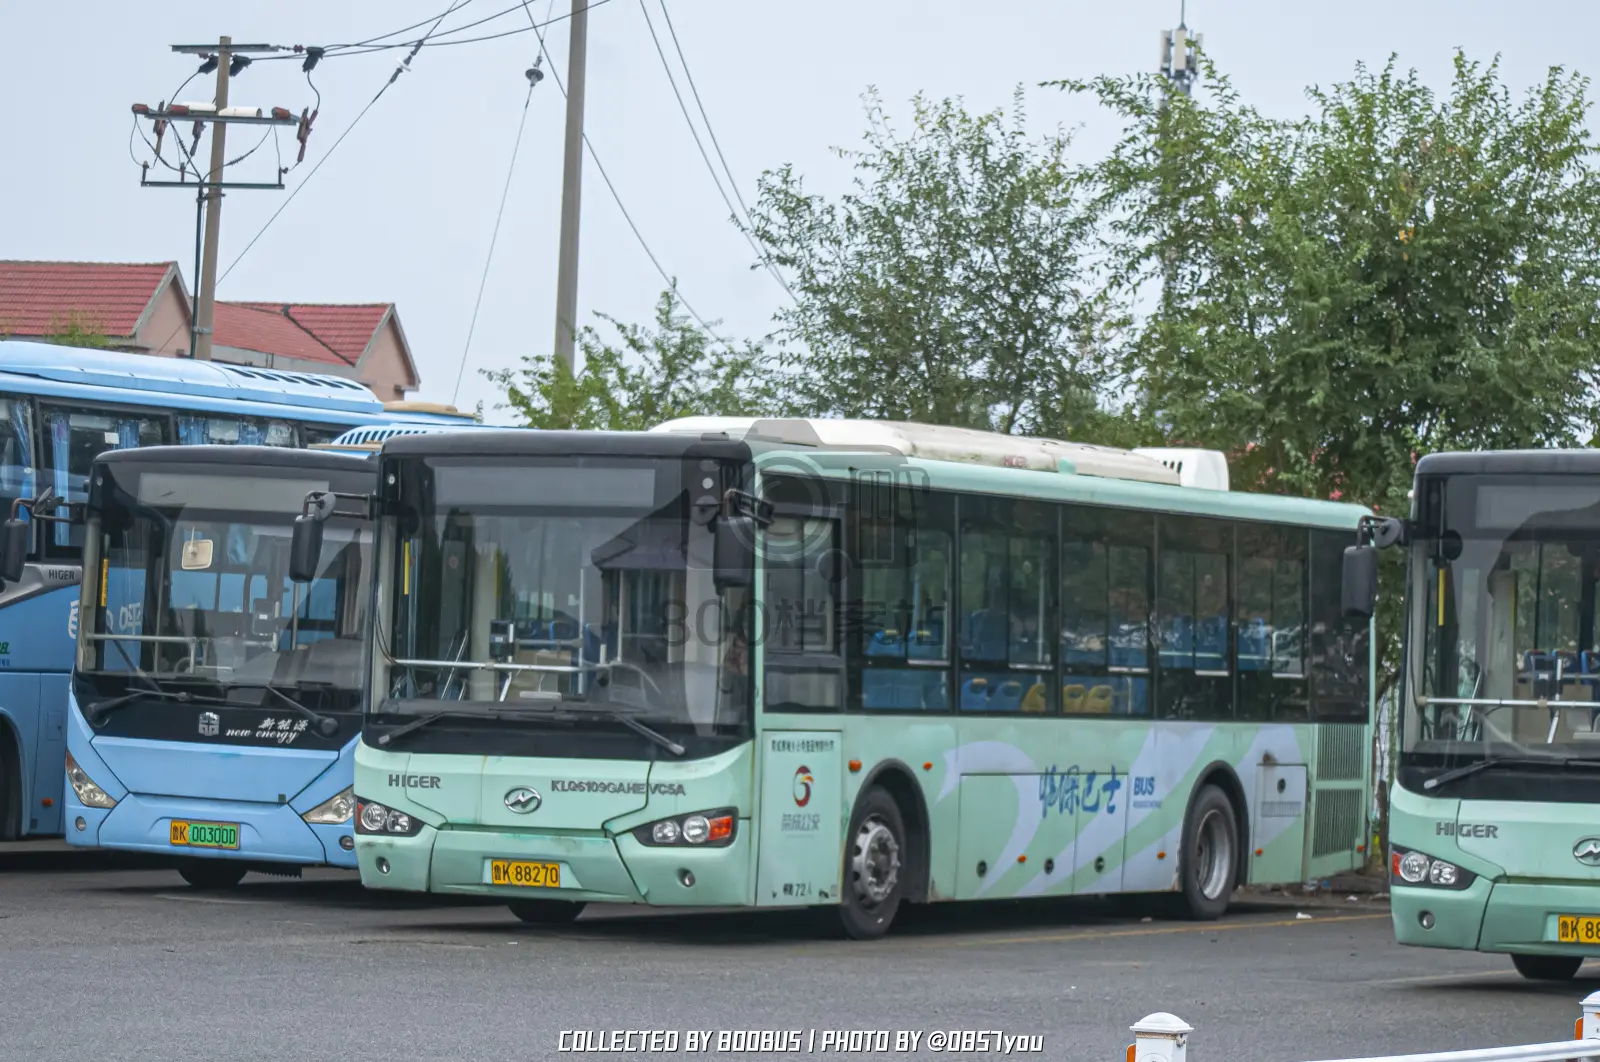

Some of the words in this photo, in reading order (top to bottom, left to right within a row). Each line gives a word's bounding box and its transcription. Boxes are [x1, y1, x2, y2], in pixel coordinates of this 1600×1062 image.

[48, 569, 75, 581] HIGER
[225, 728, 252, 737] new
[255, 729, 299, 744] energy
[388, 773, 441, 789] HIGER
[1133, 776, 1155, 796] BUS
[1435, 821, 1499, 838] HIGER
